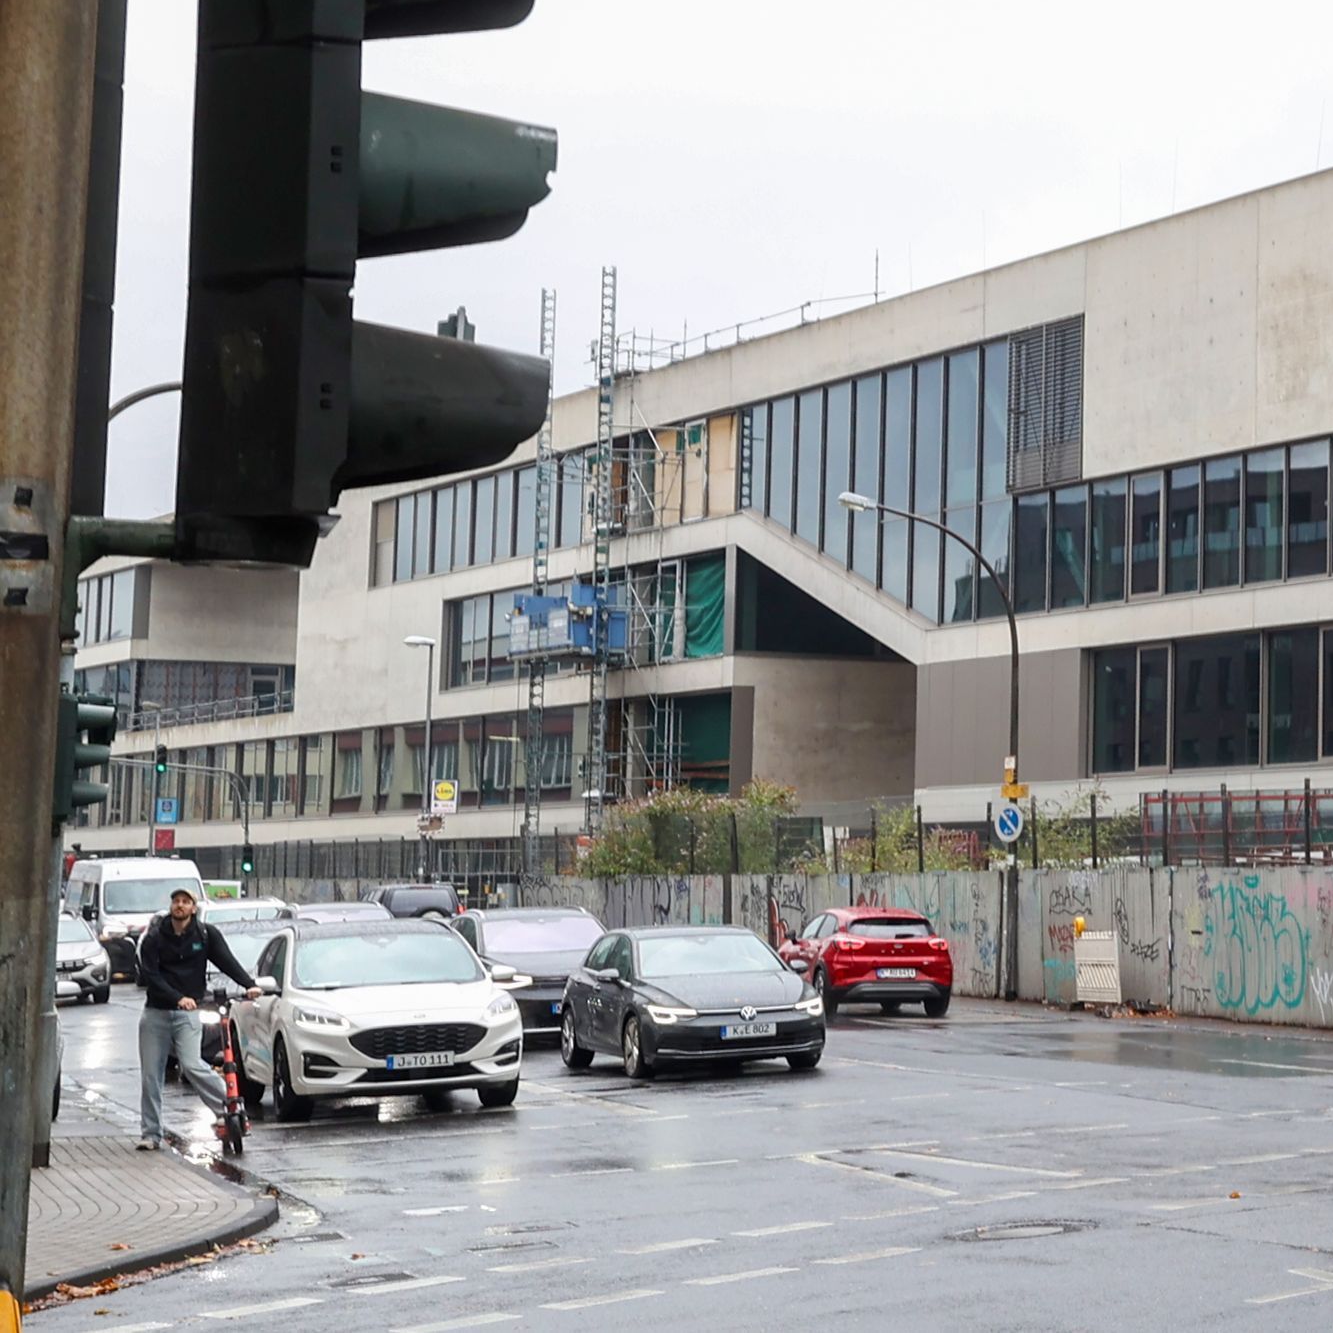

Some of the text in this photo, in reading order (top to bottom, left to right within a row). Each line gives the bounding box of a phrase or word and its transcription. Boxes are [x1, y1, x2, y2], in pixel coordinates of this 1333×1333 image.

[732, 1026, 741, 1035] K
[753, 1024, 770, 1034] 802
[413, 1055, 427, 1066] TO
[430, 1054, 449, 1065] 111
